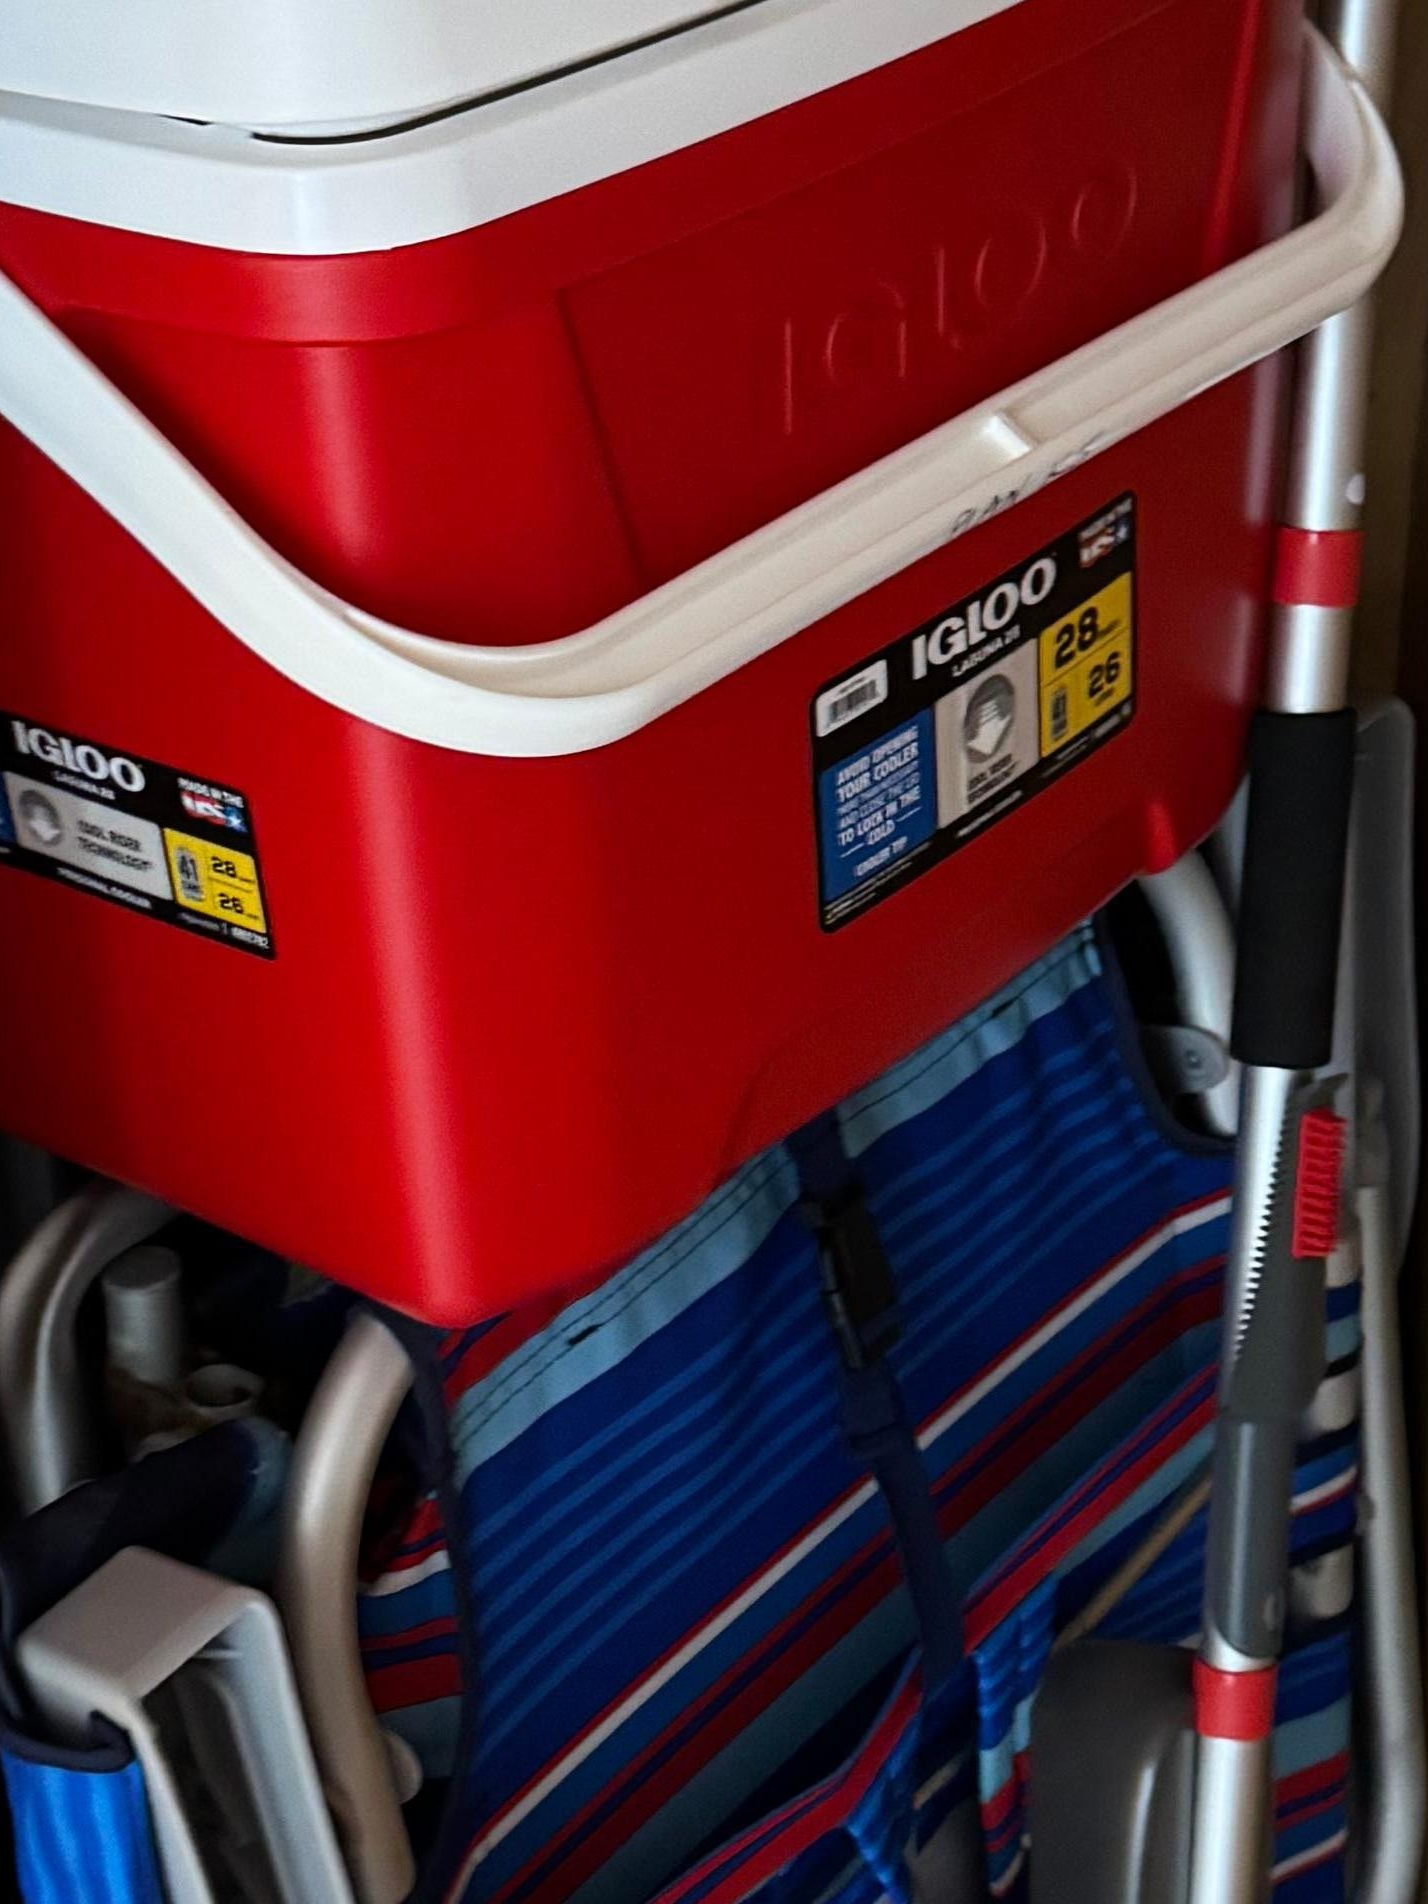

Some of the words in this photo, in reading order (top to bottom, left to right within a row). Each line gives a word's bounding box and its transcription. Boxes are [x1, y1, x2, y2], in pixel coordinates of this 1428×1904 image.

[912, 556, 1057, 680] IGLOO
[1055, 606, 1099, 670] 28
[1088, 650, 1121, 698] 26
[11, 720, 146, 792] IGLOO
[211, 856, 237, 878] 28
